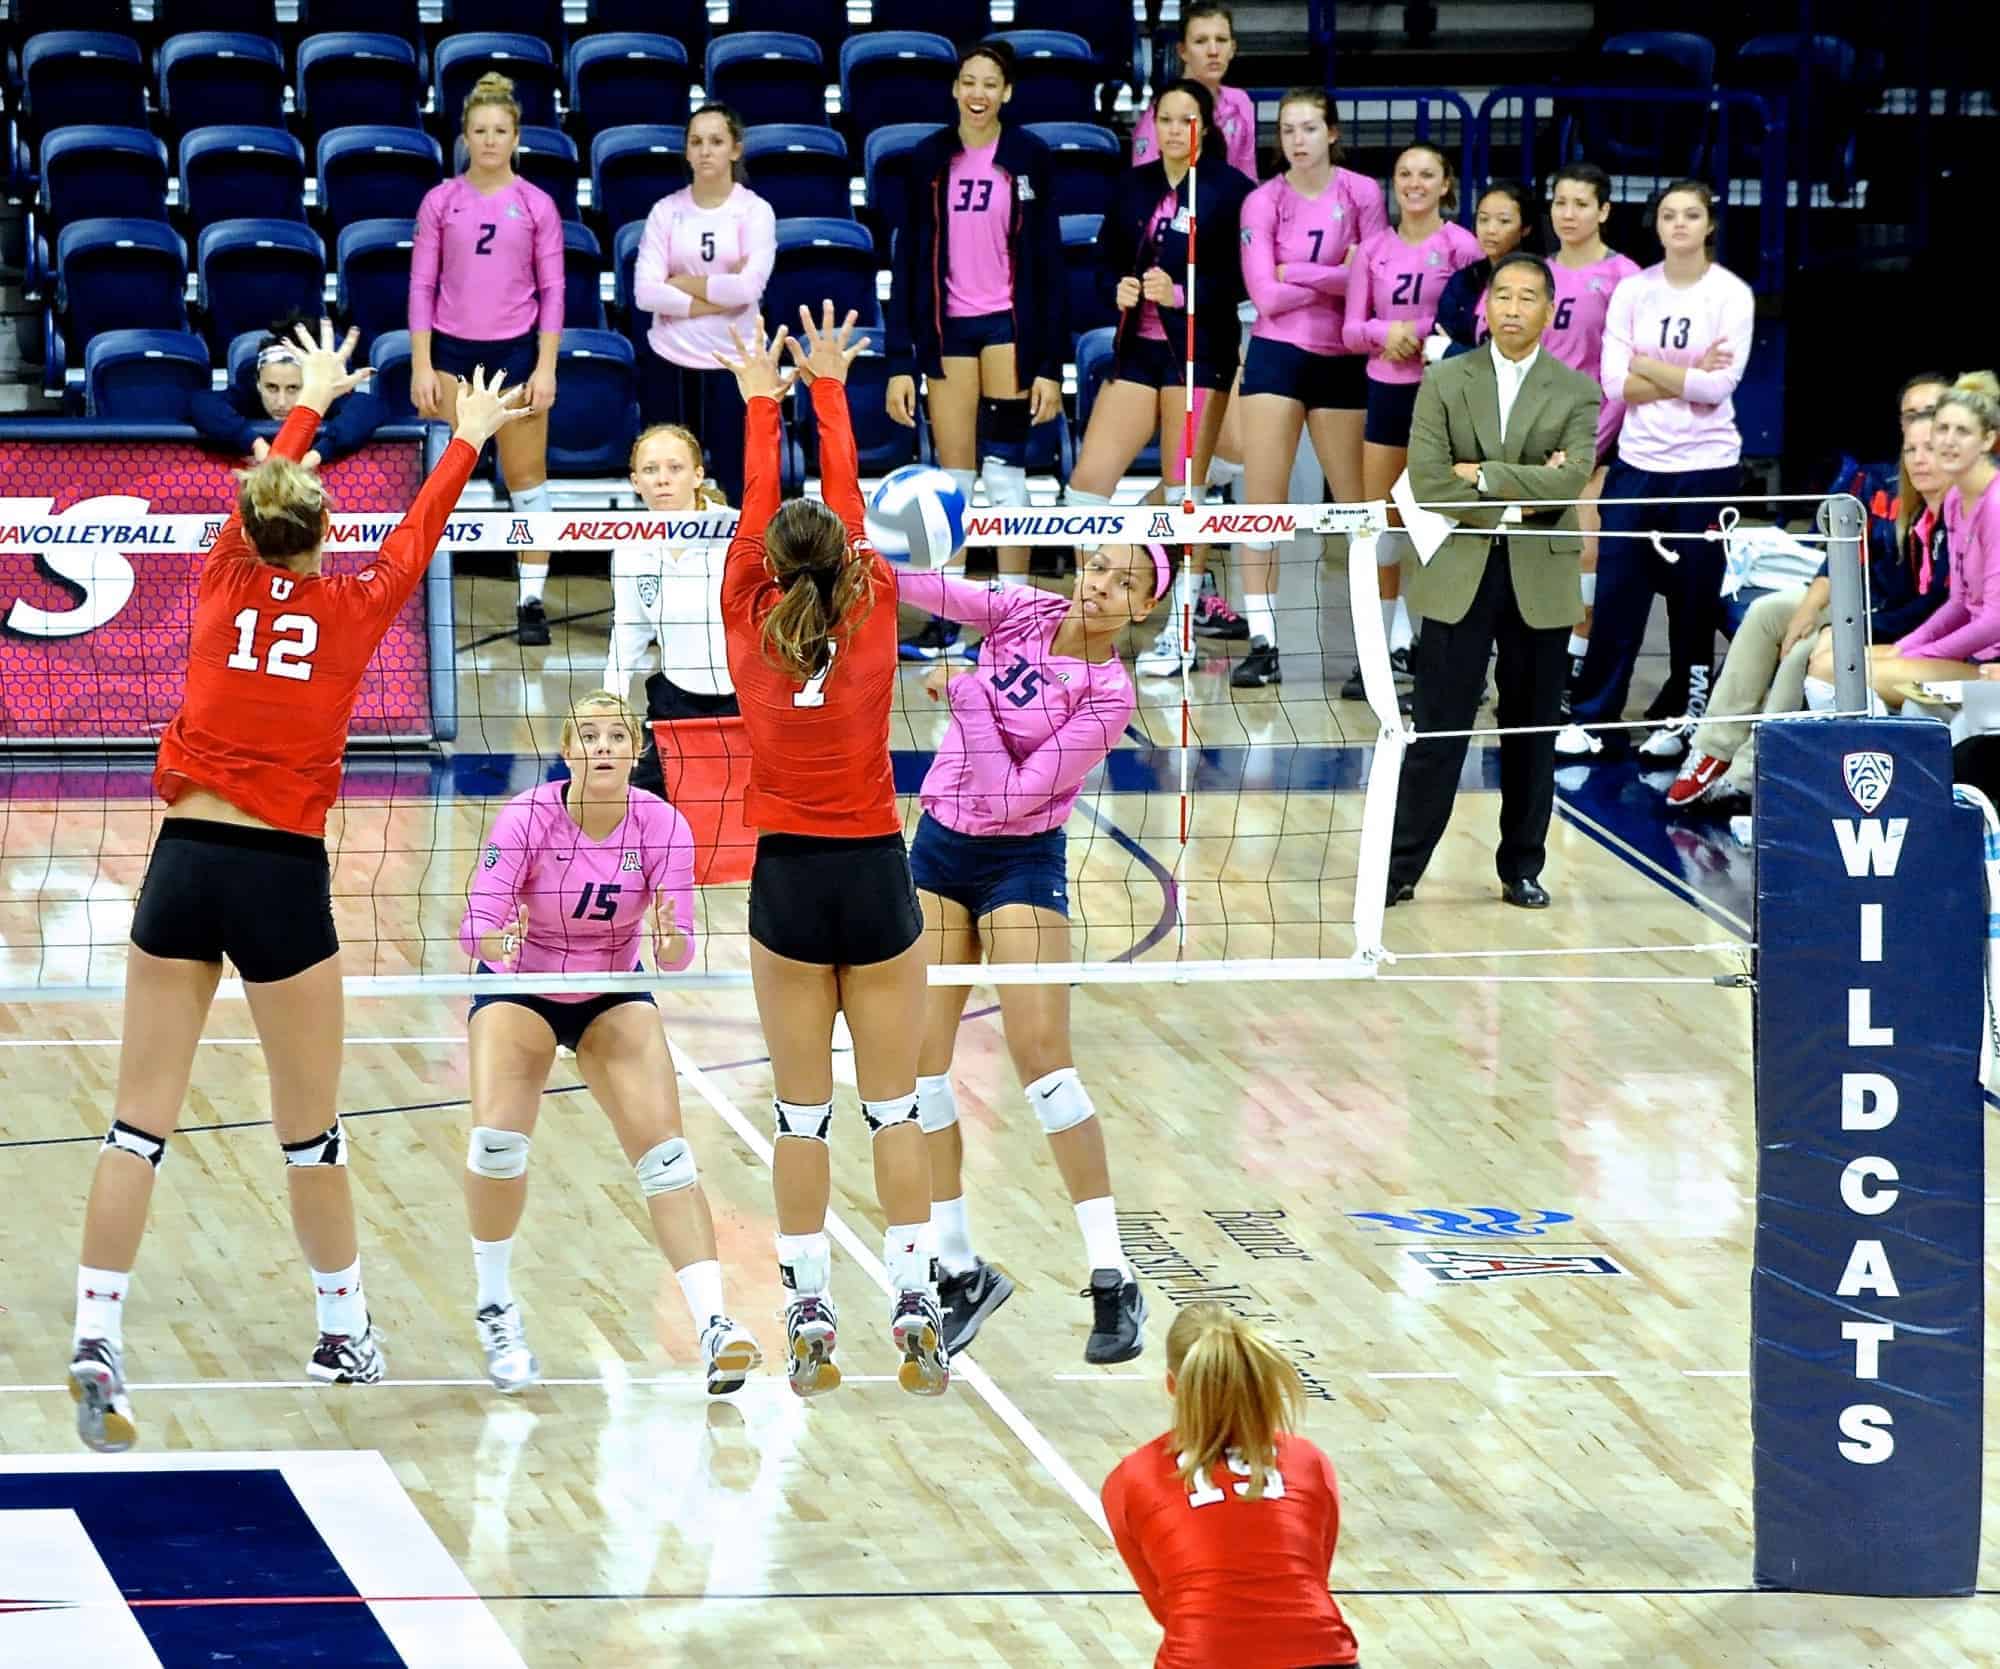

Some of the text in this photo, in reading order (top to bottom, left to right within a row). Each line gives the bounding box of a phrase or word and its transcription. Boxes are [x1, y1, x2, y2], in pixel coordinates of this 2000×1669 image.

[954, 179, 993, 212] 33
[475, 223, 496, 255] 2
[700, 232, 715, 262] 5
[1308, 229, 1324, 263] 7
[1392, 273, 1424, 305] 21
[1553, 298, 1576, 330] 6
[1660, 316, 1691, 349] 13
[507, 519, 534, 544] A
[1148, 513, 1175, 537] A
[1199, 515, 1296, 533] ARIZON
[270, 576, 294, 600] U
[227, 608, 319, 681] 12
[990, 653, 1051, 708] 35
[622, 851, 643, 871] A
[571, 882, 622, 921] 15
[1832, 818, 1909, 1465] WILDCATS
